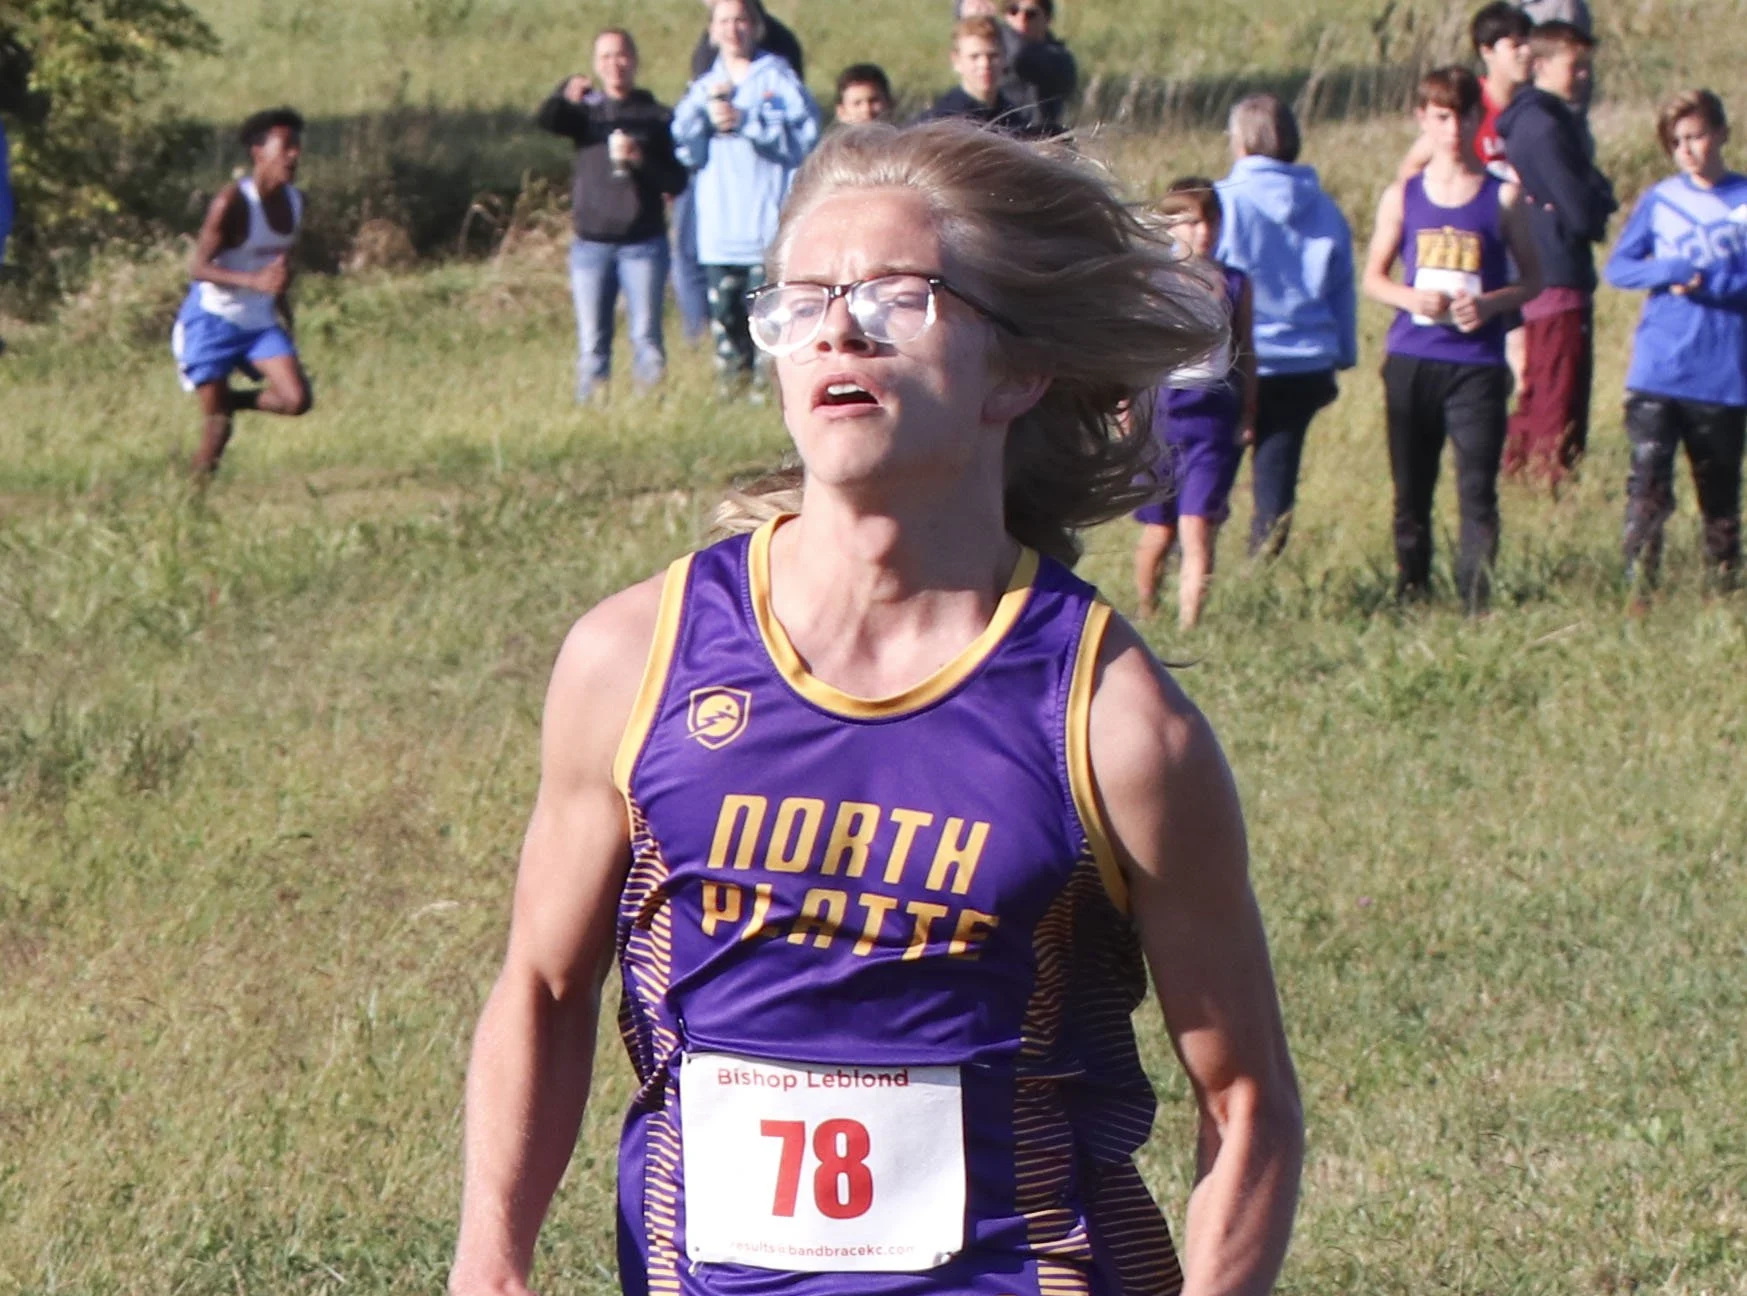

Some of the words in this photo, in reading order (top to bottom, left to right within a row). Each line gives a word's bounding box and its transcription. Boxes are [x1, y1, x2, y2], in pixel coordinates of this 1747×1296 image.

[706, 794, 991, 895] NORTH
[700, 879, 999, 961] PLATTE
[717, 1067, 798, 1092] Bishop
[806, 1065, 910, 1088] Leblond
[760, 1117, 874, 1220] 78
